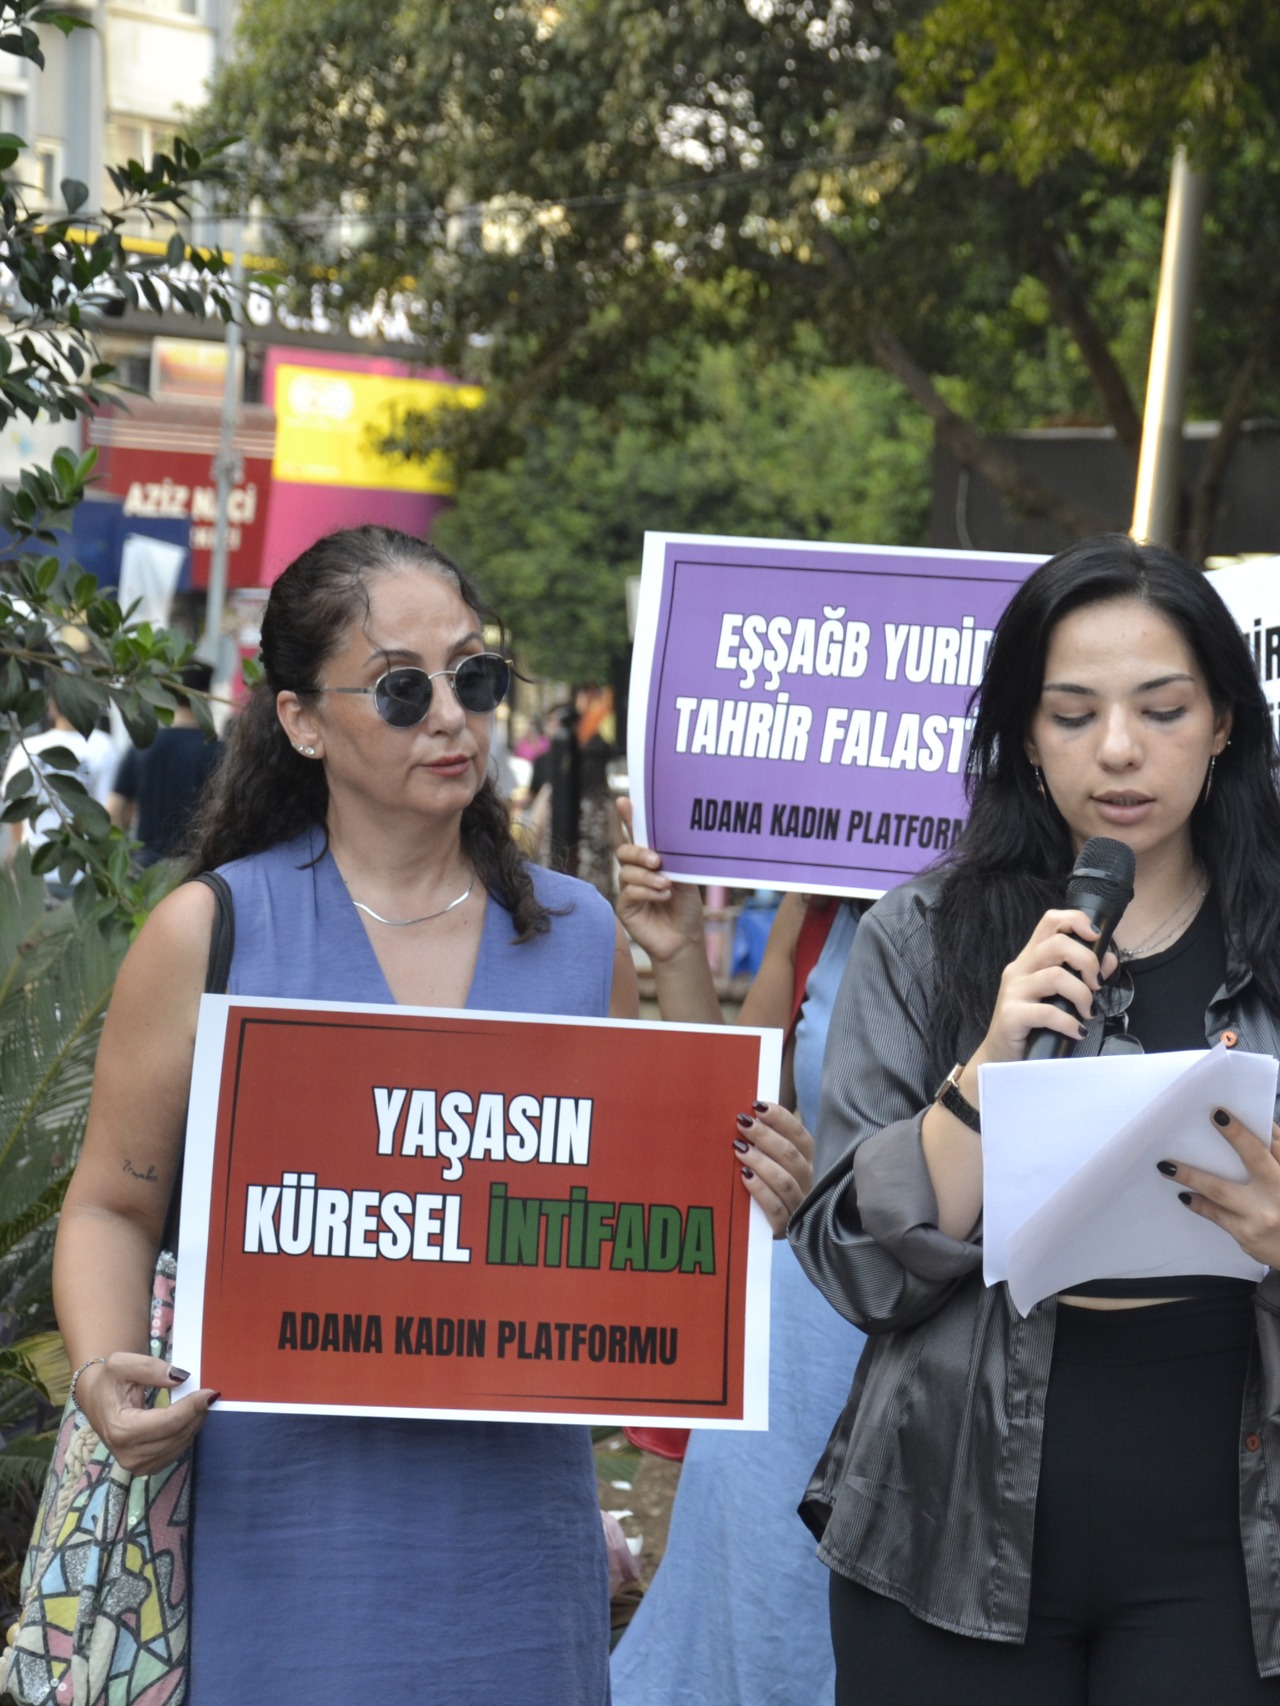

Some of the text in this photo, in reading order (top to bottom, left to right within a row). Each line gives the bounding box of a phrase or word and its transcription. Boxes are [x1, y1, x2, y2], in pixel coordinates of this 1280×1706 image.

[123, 477, 257, 524] AZİZ NCİ
[715, 606, 871, 691] EŞŞAĞB
[674, 692, 979, 774] TAHRİR FALAST
[690, 797, 762, 836] ADANA
[770, 803, 841, 841] KADIN
[372, 1085, 594, 1181] YAŞASIN
[242, 1171, 716, 1275] KÜRESEL İNTİFADA
[277, 1311, 678, 1365] ADANA KADIN PLATFORMU
